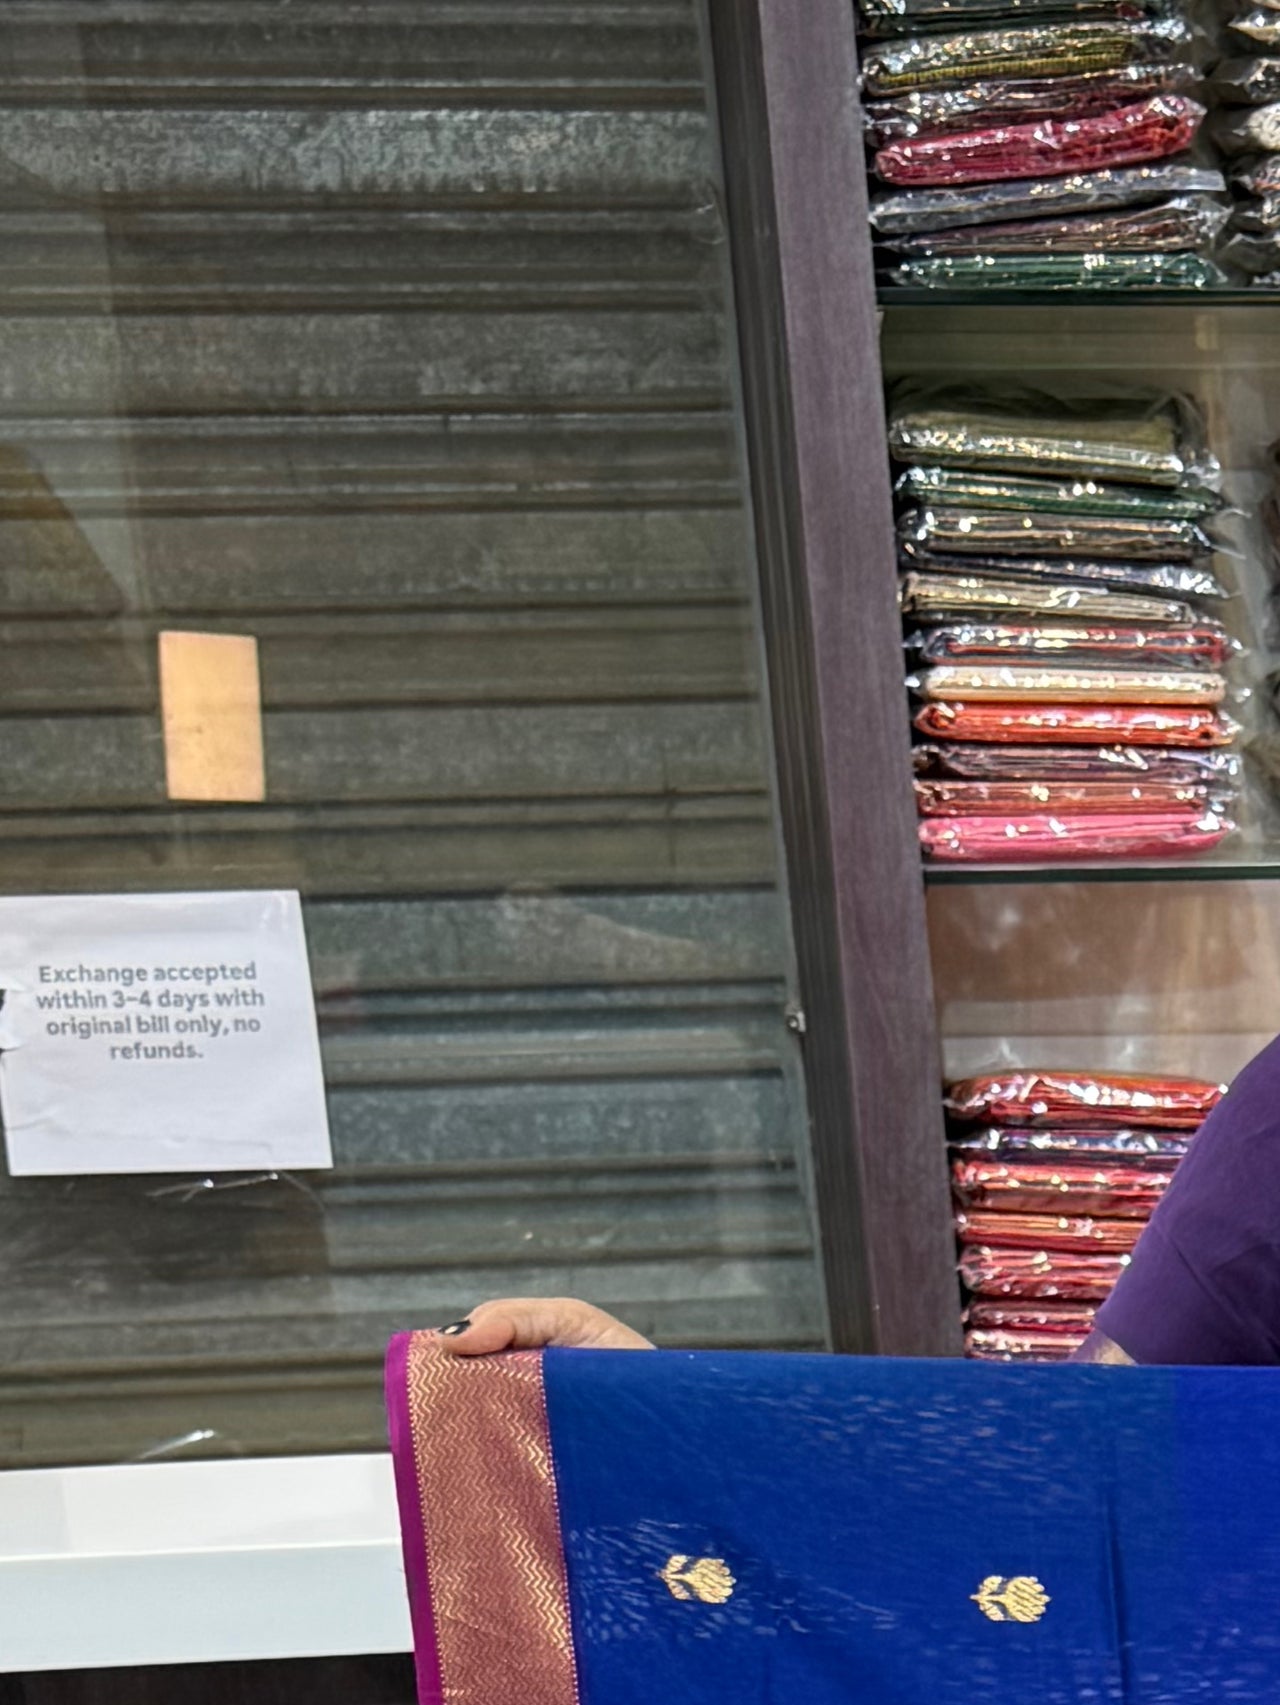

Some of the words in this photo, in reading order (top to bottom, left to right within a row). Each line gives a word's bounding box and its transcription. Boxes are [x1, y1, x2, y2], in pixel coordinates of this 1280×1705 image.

[38, 964, 148, 987] Exchange
[153, 962, 257, 985] accepted
[36, 989, 108, 1009] within
[157, 989, 210, 1012] days
[214, 987, 265, 1007] with
[46, 1015, 131, 1039] original
[136, 1015, 170, 1033] bill
[174, 1014, 230, 1037] only,
[234, 1017, 261, 1033] no
[110, 1041, 204, 1060] refunds.
